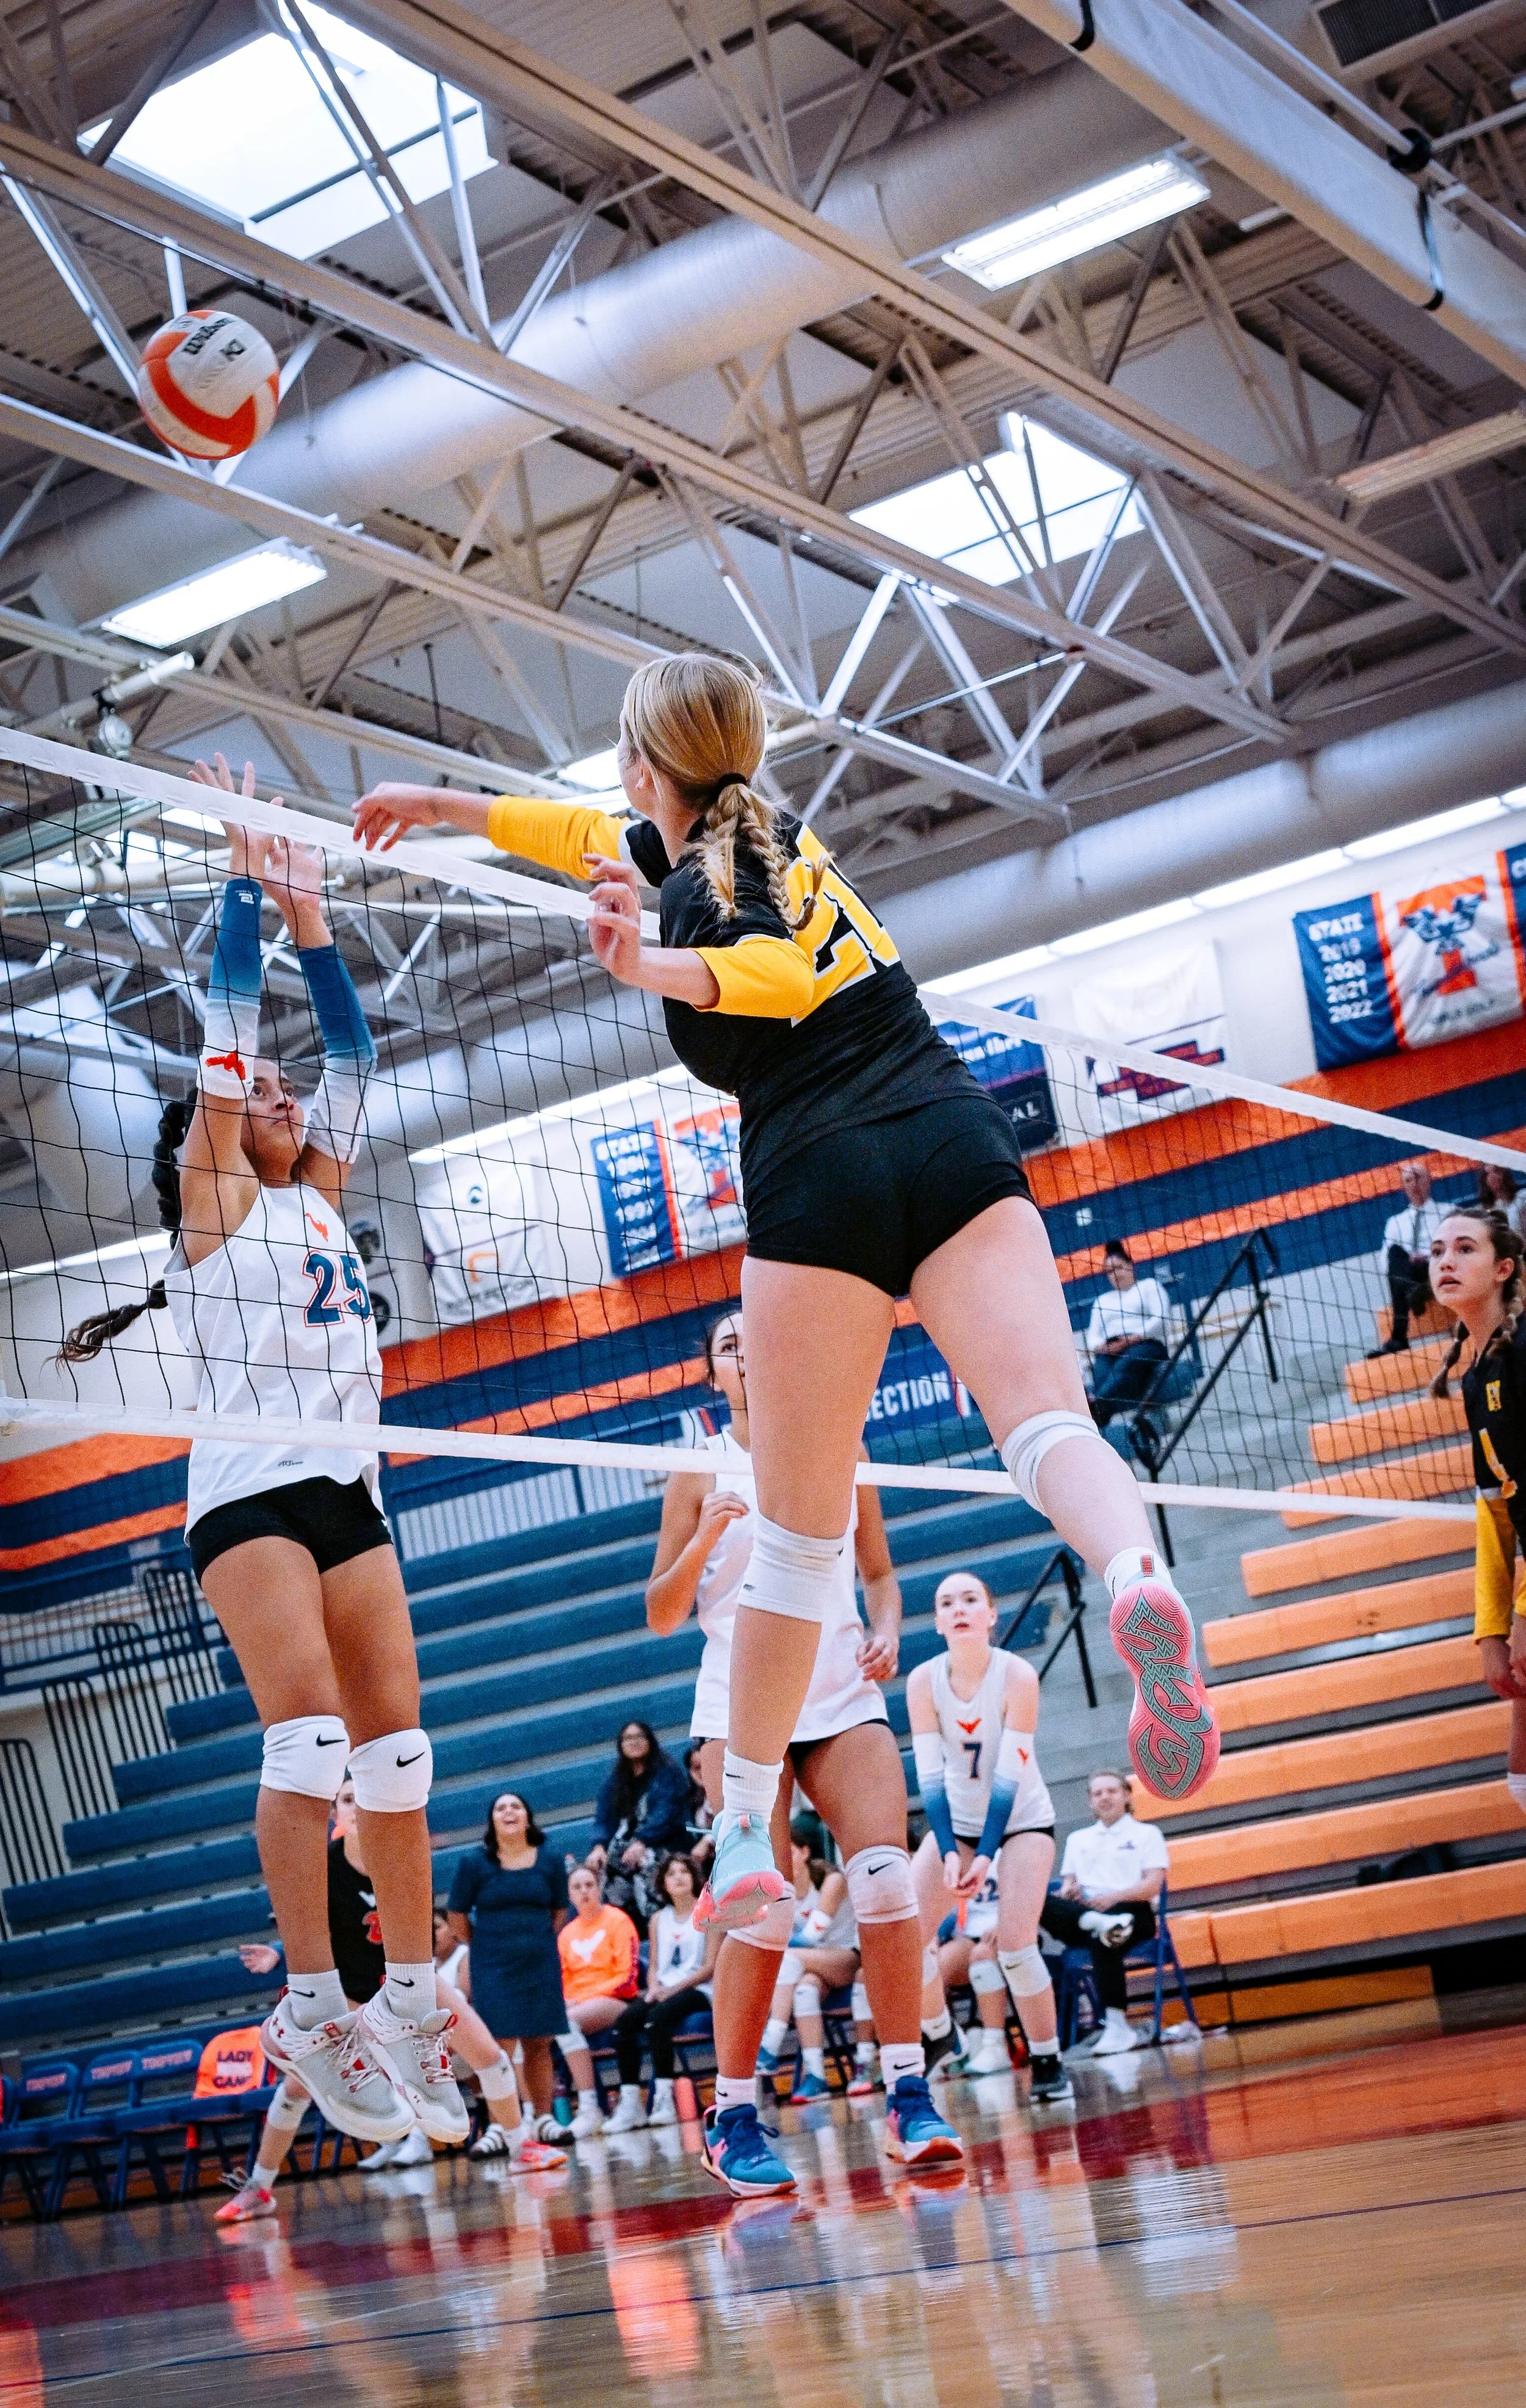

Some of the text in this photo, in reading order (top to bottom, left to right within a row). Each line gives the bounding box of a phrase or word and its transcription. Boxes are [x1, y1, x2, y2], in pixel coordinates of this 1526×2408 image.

[1308, 912, 1364, 941] STATE
[595, 1132, 654, 1161] STATE
[302, 1250, 374, 1328] 25
[866, 1370, 951, 1423] ECTION
[961, 1741, 983, 1780] 7
[217, 2050, 253, 2064] LADY
